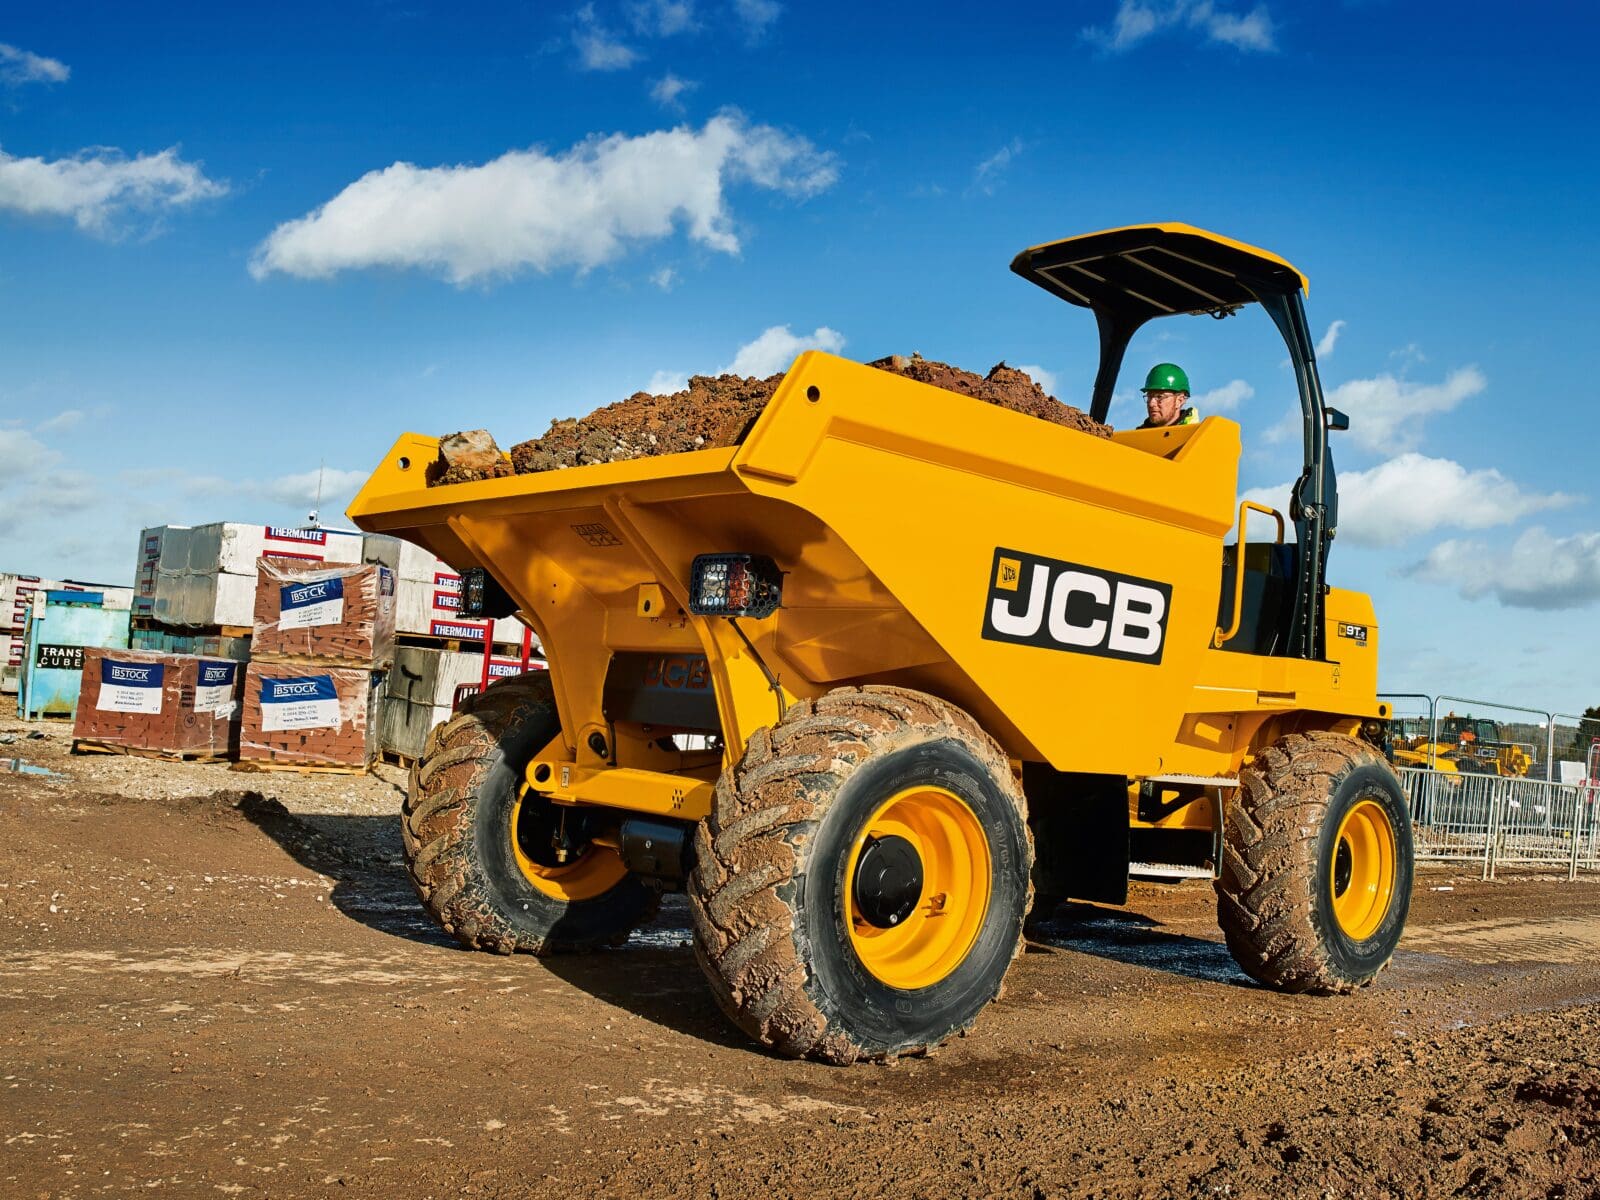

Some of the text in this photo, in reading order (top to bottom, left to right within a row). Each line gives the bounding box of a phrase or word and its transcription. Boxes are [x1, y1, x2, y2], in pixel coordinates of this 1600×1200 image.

[270, 527, 323, 541] THERMALITE
[1003, 566, 1016, 581] JCB
[291, 586, 326, 601] IBSTCK
[991, 564, 1165, 656] JCB
[434, 624, 485, 639] THERMALITE
[42, 647, 82, 658] TRANS
[41, 657, 81, 667] CUBE
[112, 668, 149, 680] IBSTOCK
[488, 664, 522, 677] THERMA
[274, 684, 318, 695] IBSTOCK
[1474, 748, 1497, 758] JCB
